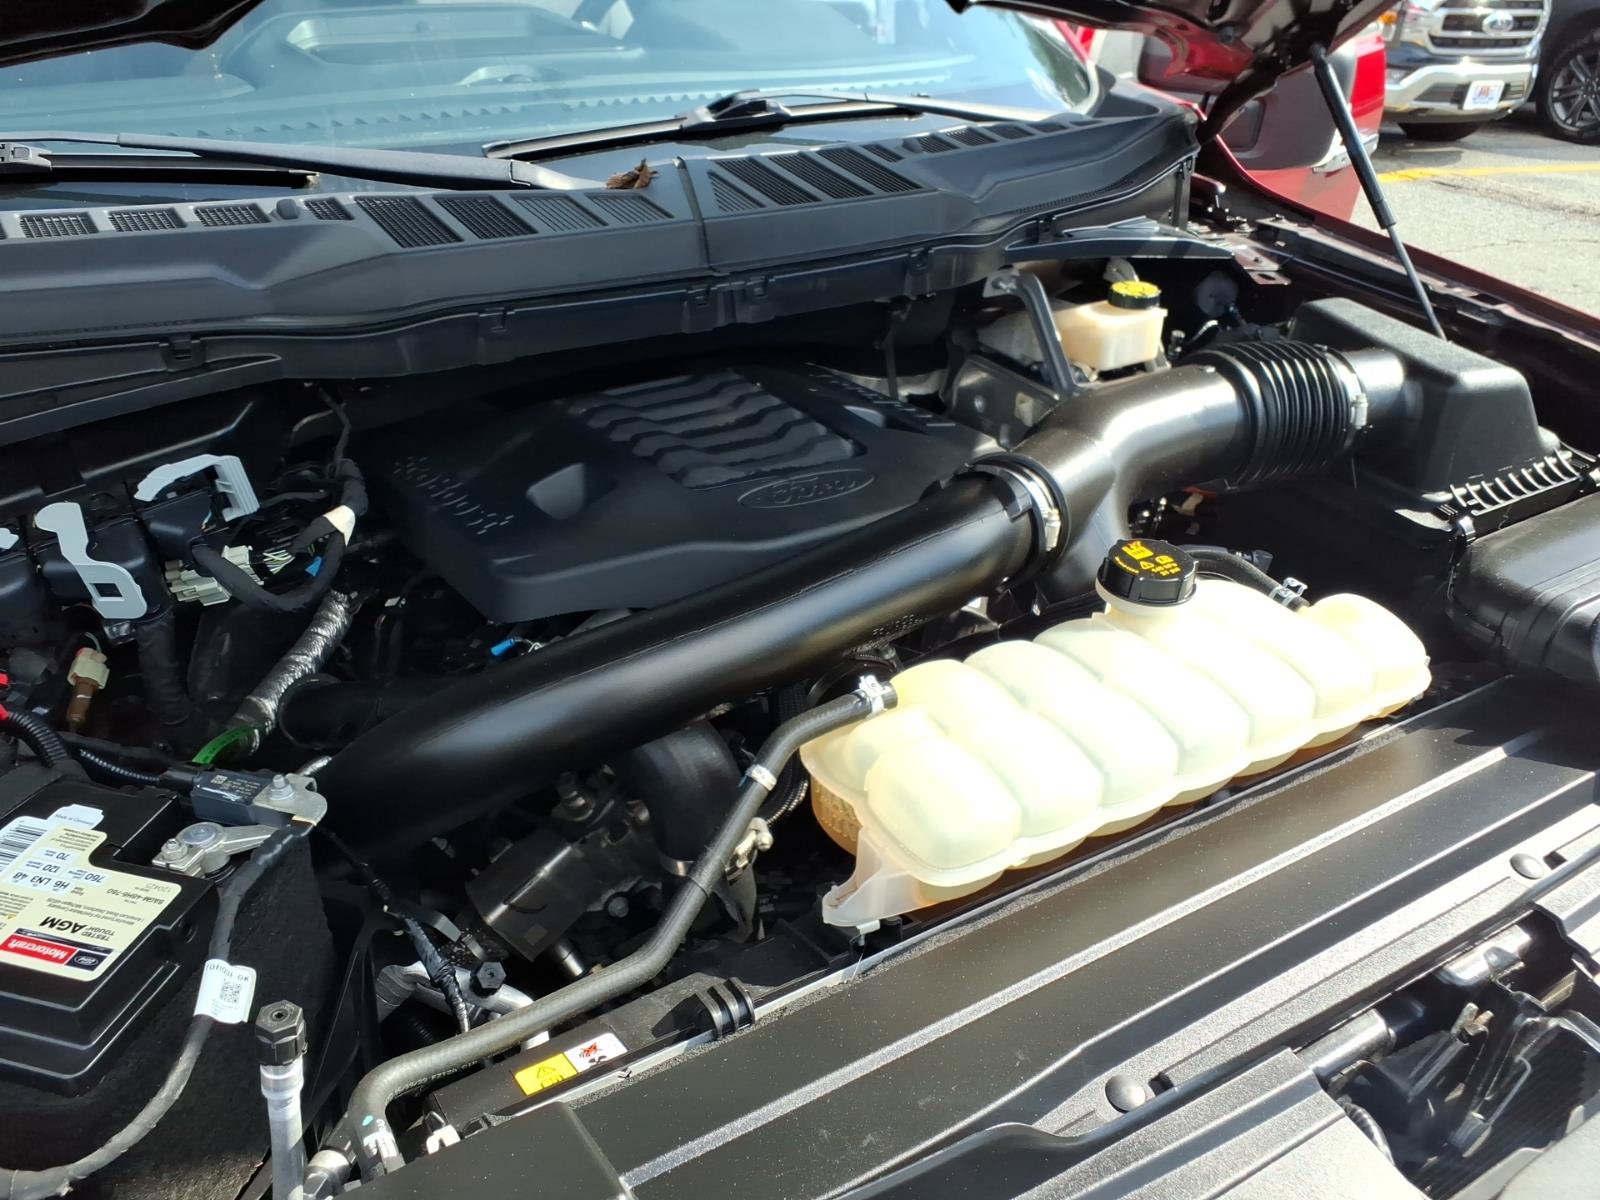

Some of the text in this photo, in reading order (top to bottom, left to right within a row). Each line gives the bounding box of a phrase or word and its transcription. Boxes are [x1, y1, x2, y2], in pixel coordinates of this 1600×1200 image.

[56, 852, 71, 860] 70
[42, 864, 61, 873] 120
[13, 872, 71, 889] H6 LN3 48
[84, 873, 106, 883] 760
[39, 916, 88, 933] AGM
[81, 931, 111, 941] TESTED
[7, 939, 69, 960] Motorcraft
